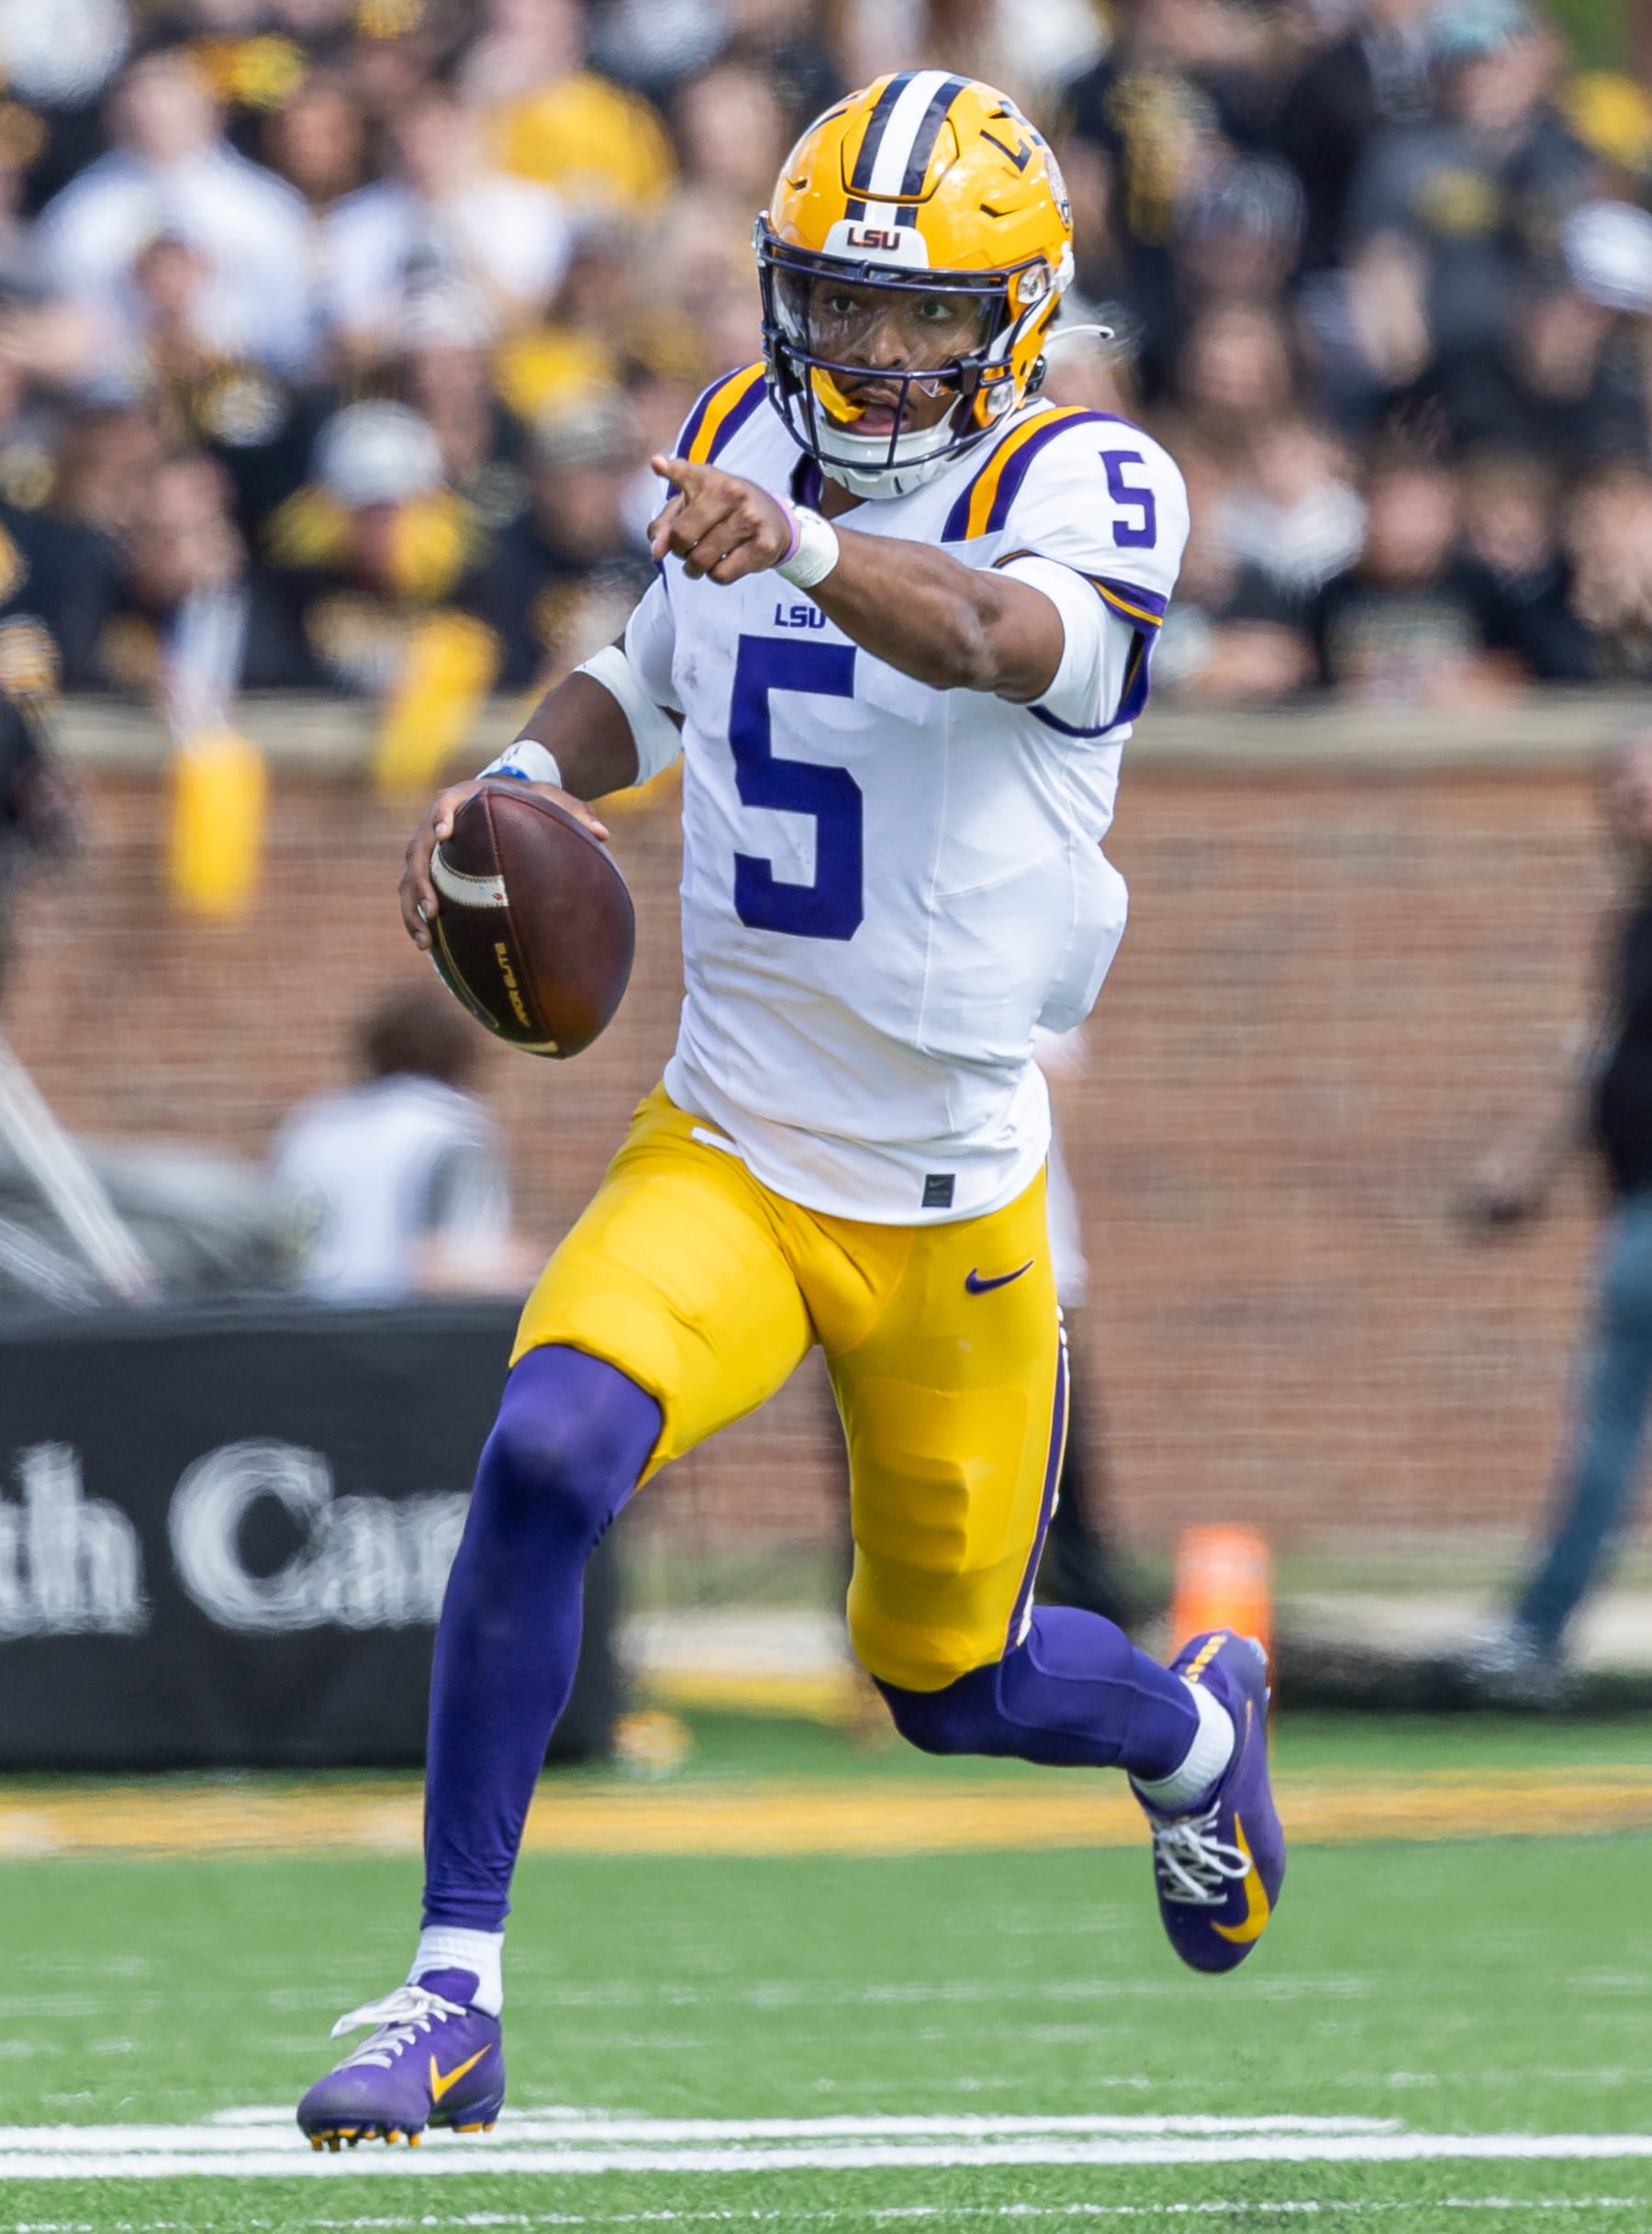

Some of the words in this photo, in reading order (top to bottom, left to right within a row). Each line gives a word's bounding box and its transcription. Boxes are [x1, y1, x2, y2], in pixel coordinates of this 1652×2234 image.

[847, 227, 900, 251] LSU
[1099, 450, 1156, 549] 5
[774, 603, 827, 629] LSU
[729, 633, 865, 941] 5
